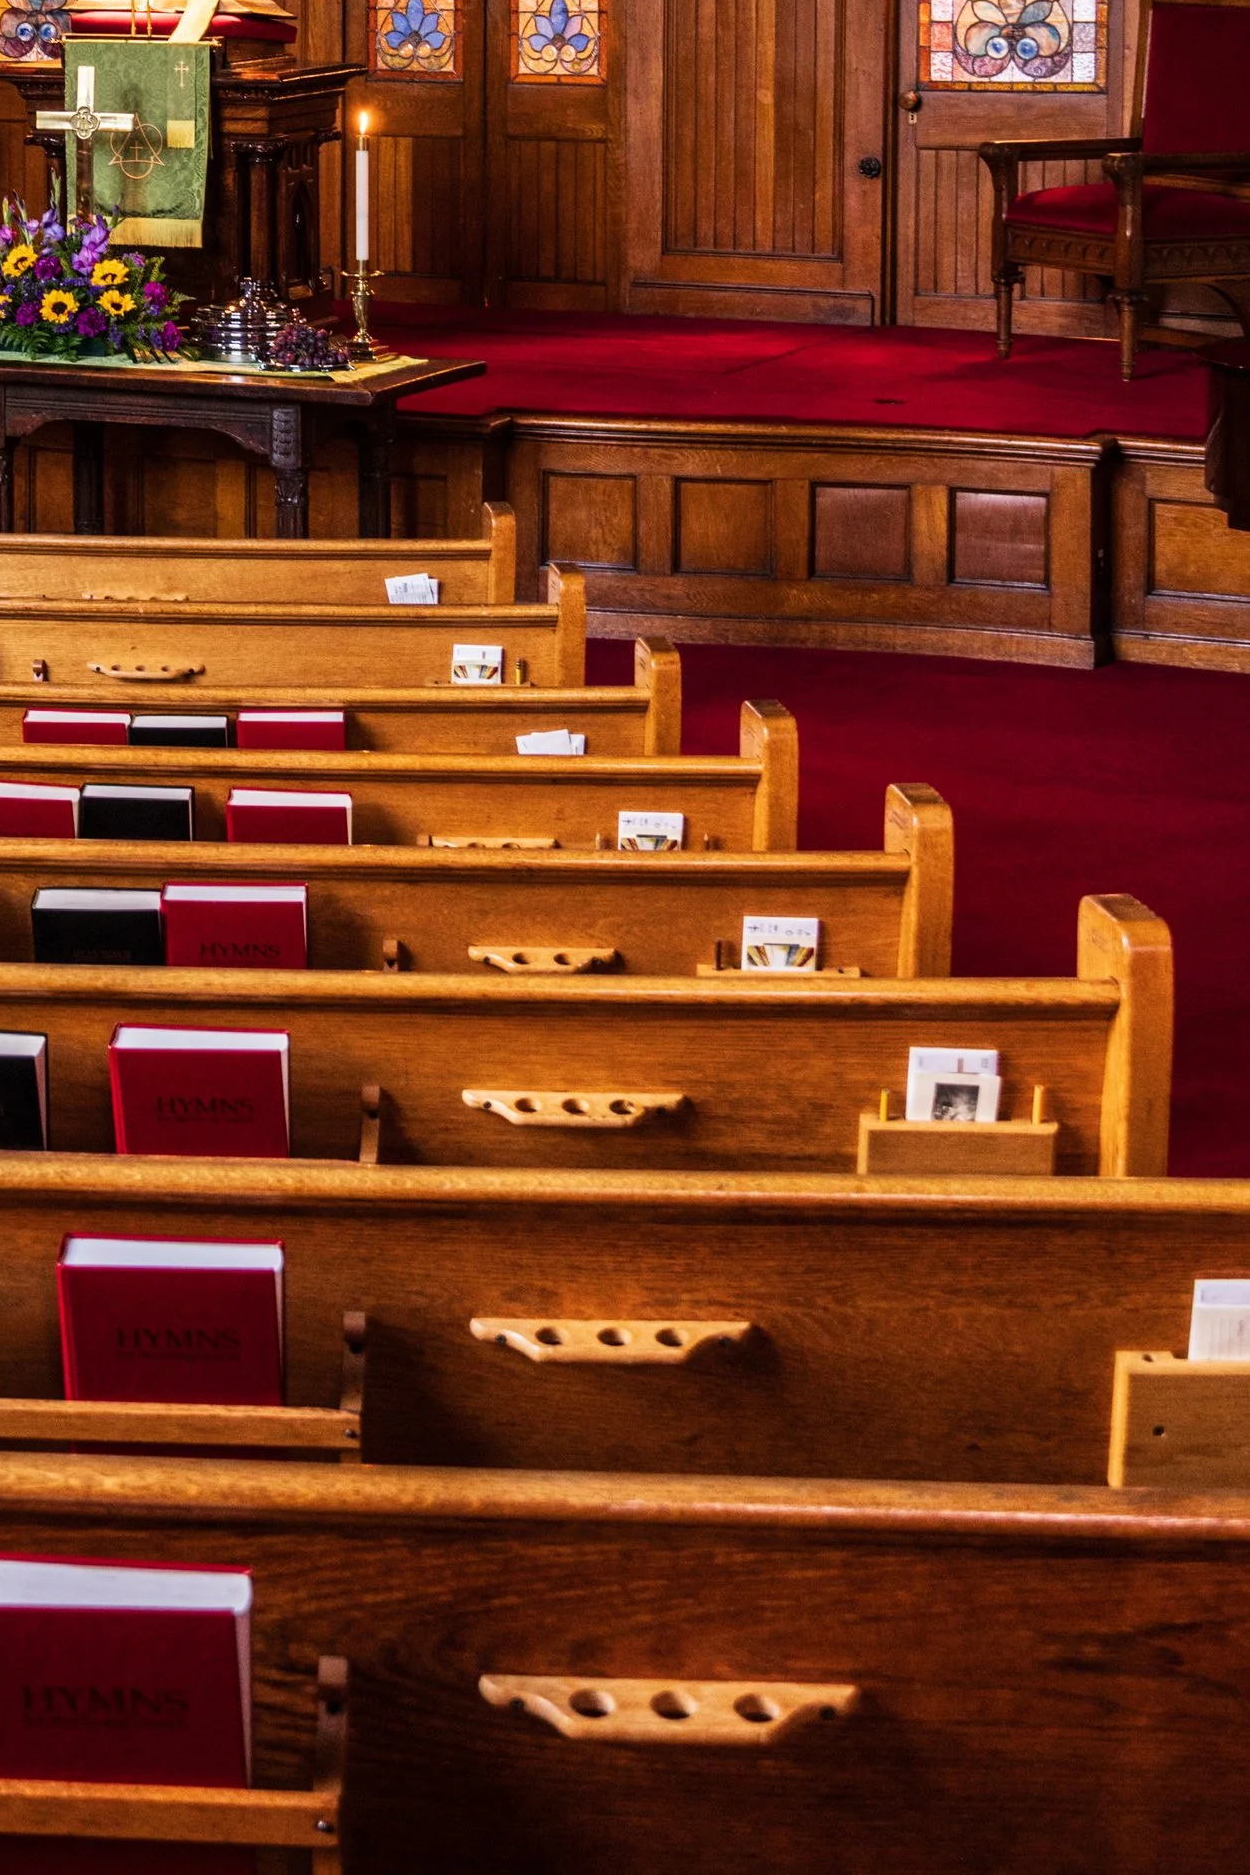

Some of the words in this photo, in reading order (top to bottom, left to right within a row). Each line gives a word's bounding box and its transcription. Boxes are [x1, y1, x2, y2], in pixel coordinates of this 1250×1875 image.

[200, 942, 281, 958] HYMNS
[156, 1097, 254, 1114] HYMNS
[116, 1326, 241, 1350] HYMNS
[21, 1683, 190, 1715] HYMNS
